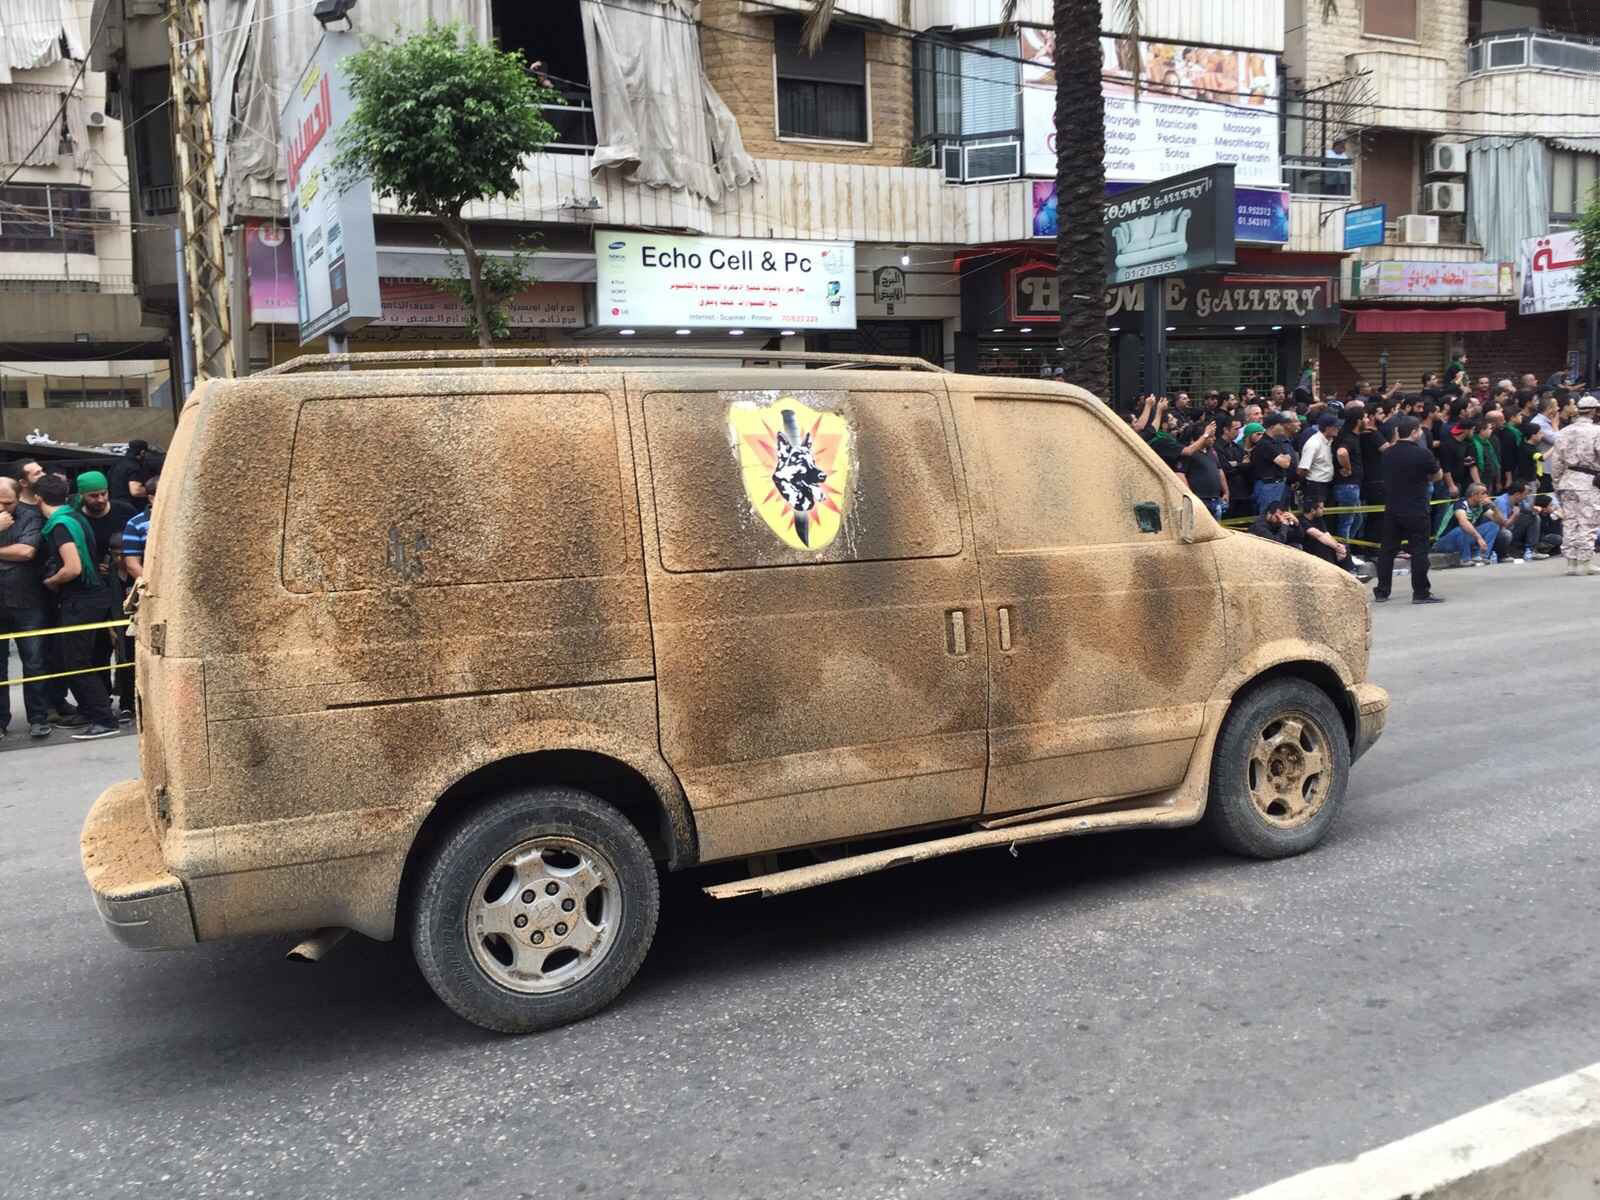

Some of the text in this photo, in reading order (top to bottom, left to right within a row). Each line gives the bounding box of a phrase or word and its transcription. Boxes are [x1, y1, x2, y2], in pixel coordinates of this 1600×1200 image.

[1106, 100, 1126, 110] Hair
[1155, 118, 1198, 130] Manicure
[1223, 123, 1262, 135] Massage
[1104, 130, 1136, 142] akeup
[1157, 133, 1197, 145] Pedicure
[1215, 137, 1271, 150] Mesotherapy
[1165, 148, 1190, 159] Botox
[1103, 158, 1136, 170] arafine
[1153, 184, 1203, 209] GALLERY
[641, 246, 812, 273] Echo Cell & Pc
[1021, 277, 1322, 317] HME GALLERY
